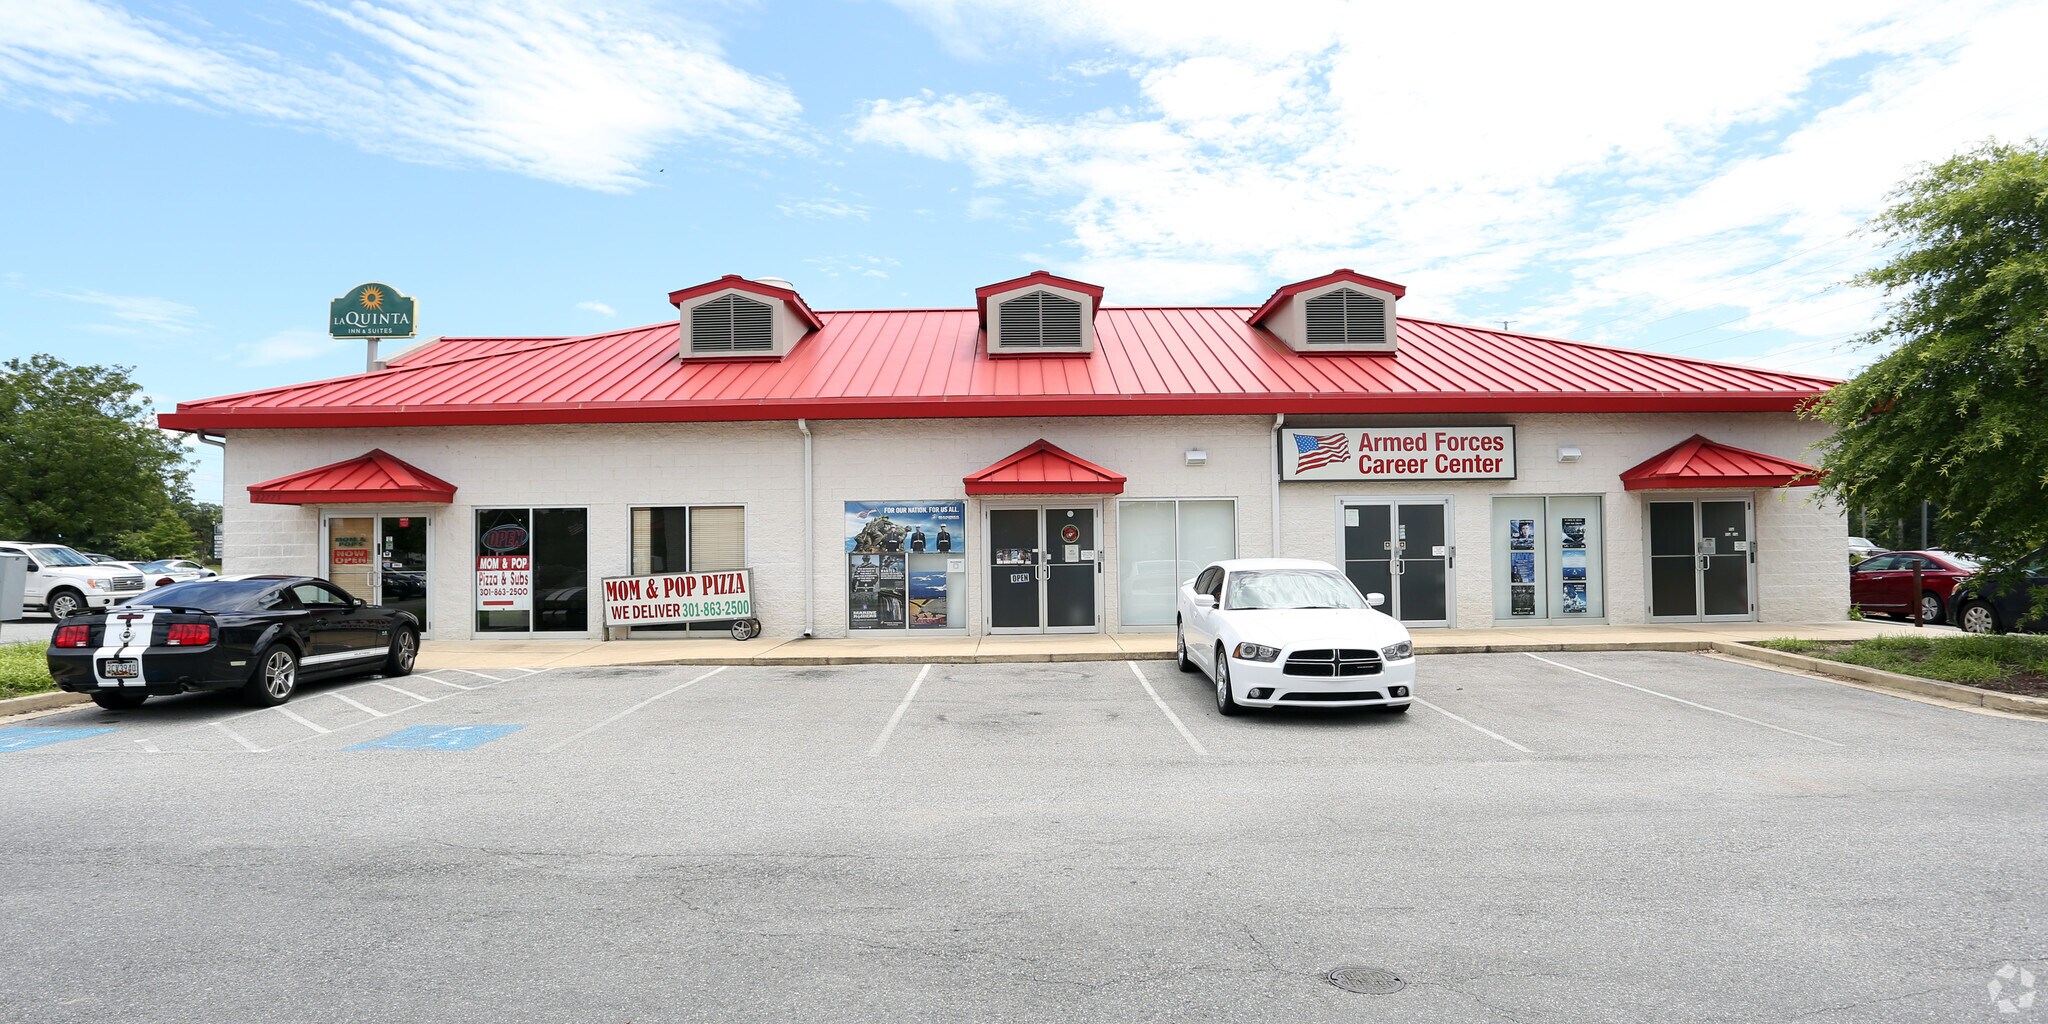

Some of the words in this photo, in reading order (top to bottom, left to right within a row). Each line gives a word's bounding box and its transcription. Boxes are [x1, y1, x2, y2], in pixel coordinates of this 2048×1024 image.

[334, 317, 345, 325] LA
[345, 311, 410, 328] QUINTA
[1358, 432, 1427, 452] Armed
[1435, 432, 1504, 452] Forces
[1358, 454, 1428, 475] Career
[1435, 453, 1504, 474] Center
[487, 529, 525, 548] OPEN
[480, 558, 499, 570] MOM
[502, 557, 508, 570] &
[511, 557, 528, 569] POP
[479, 572, 498, 586] Pizza
[501, 572, 507, 586] &
[510, 572, 529, 586] Subs
[605, 579, 642, 602] MOM
[646, 578, 659, 599] &
[663, 576, 697, 598] POP
[701, 572, 746, 596] PIZZA
[1012, 574, 1029, 583] OPEN
[480, 588, 528, 596] 301-863-2500
[611, 605, 630, 620] WE
[632, 603, 681, 619] DELIVER
[682, 599, 750, 618] 301-863-2500
